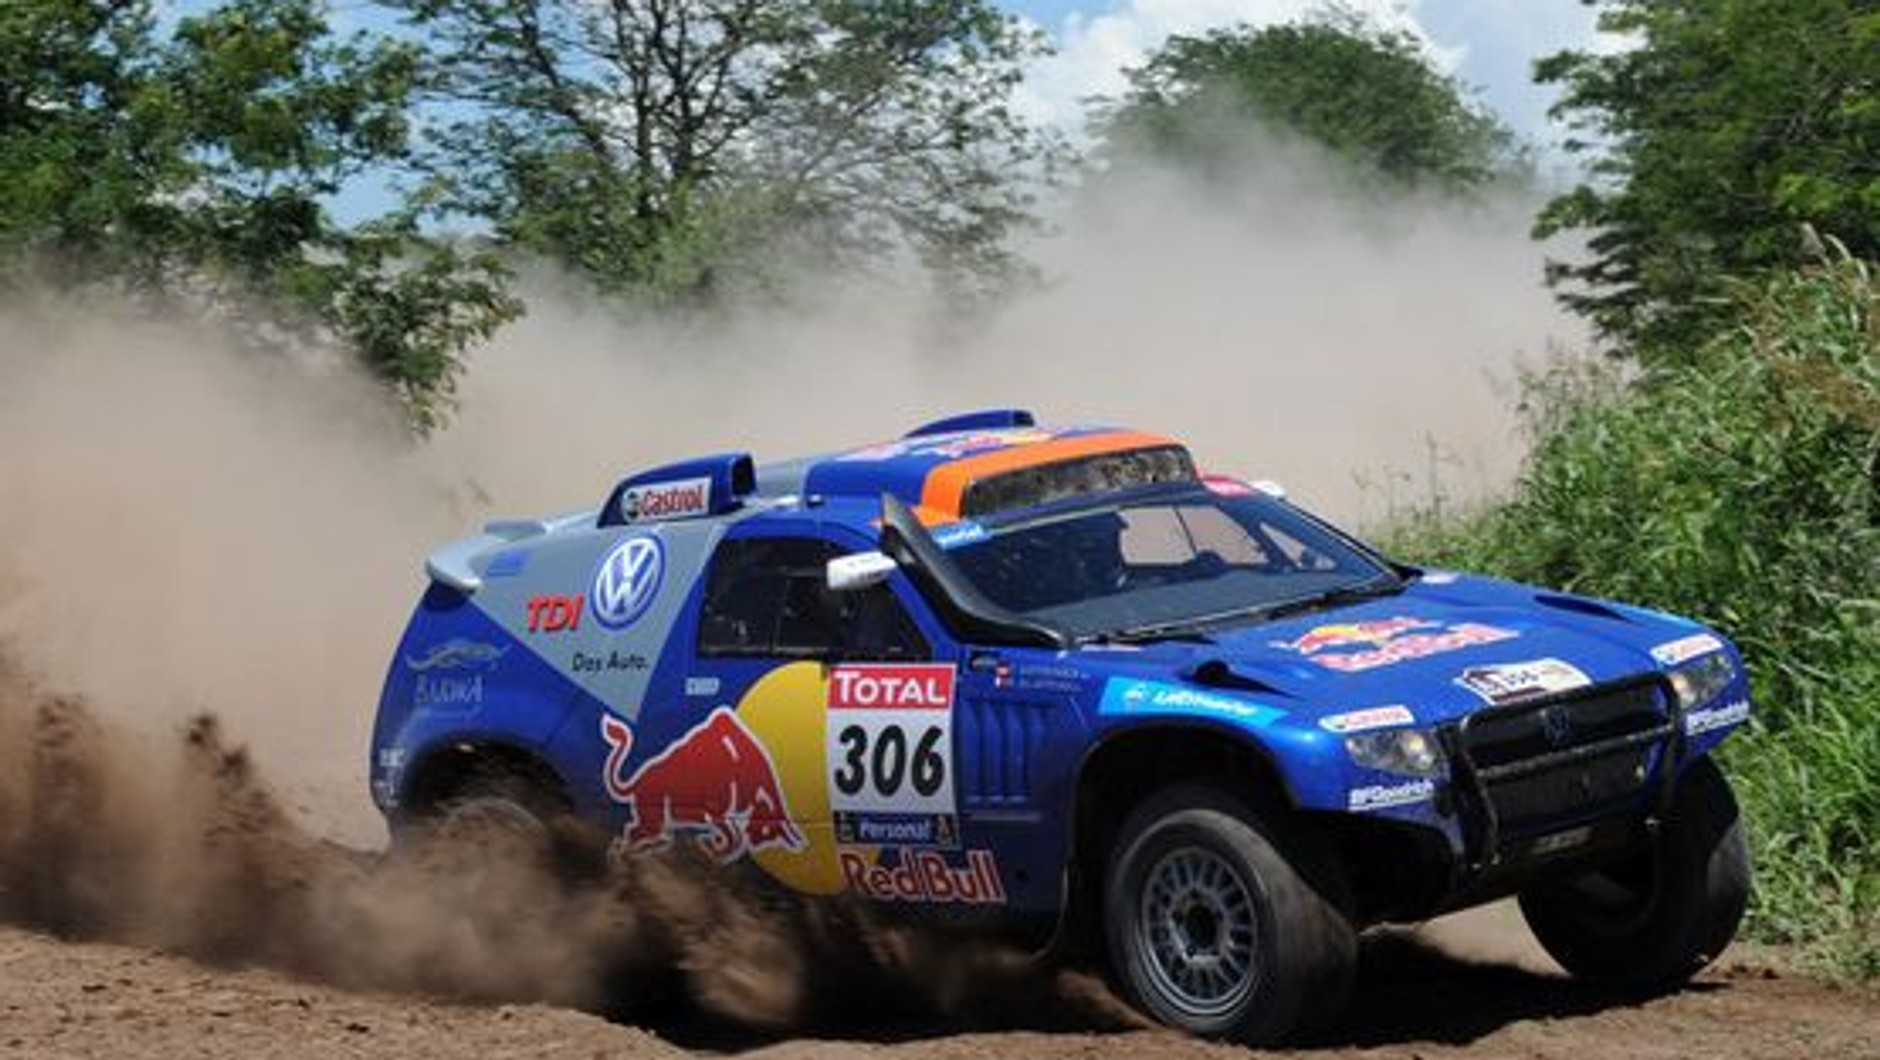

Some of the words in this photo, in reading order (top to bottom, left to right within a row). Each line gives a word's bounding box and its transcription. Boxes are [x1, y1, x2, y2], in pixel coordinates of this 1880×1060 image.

[642, 484, 705, 515] Castrol
[526, 595, 584, 633] TDI
[835, 724, 946, 797] 306
[859, 818, 931, 840] Personal
